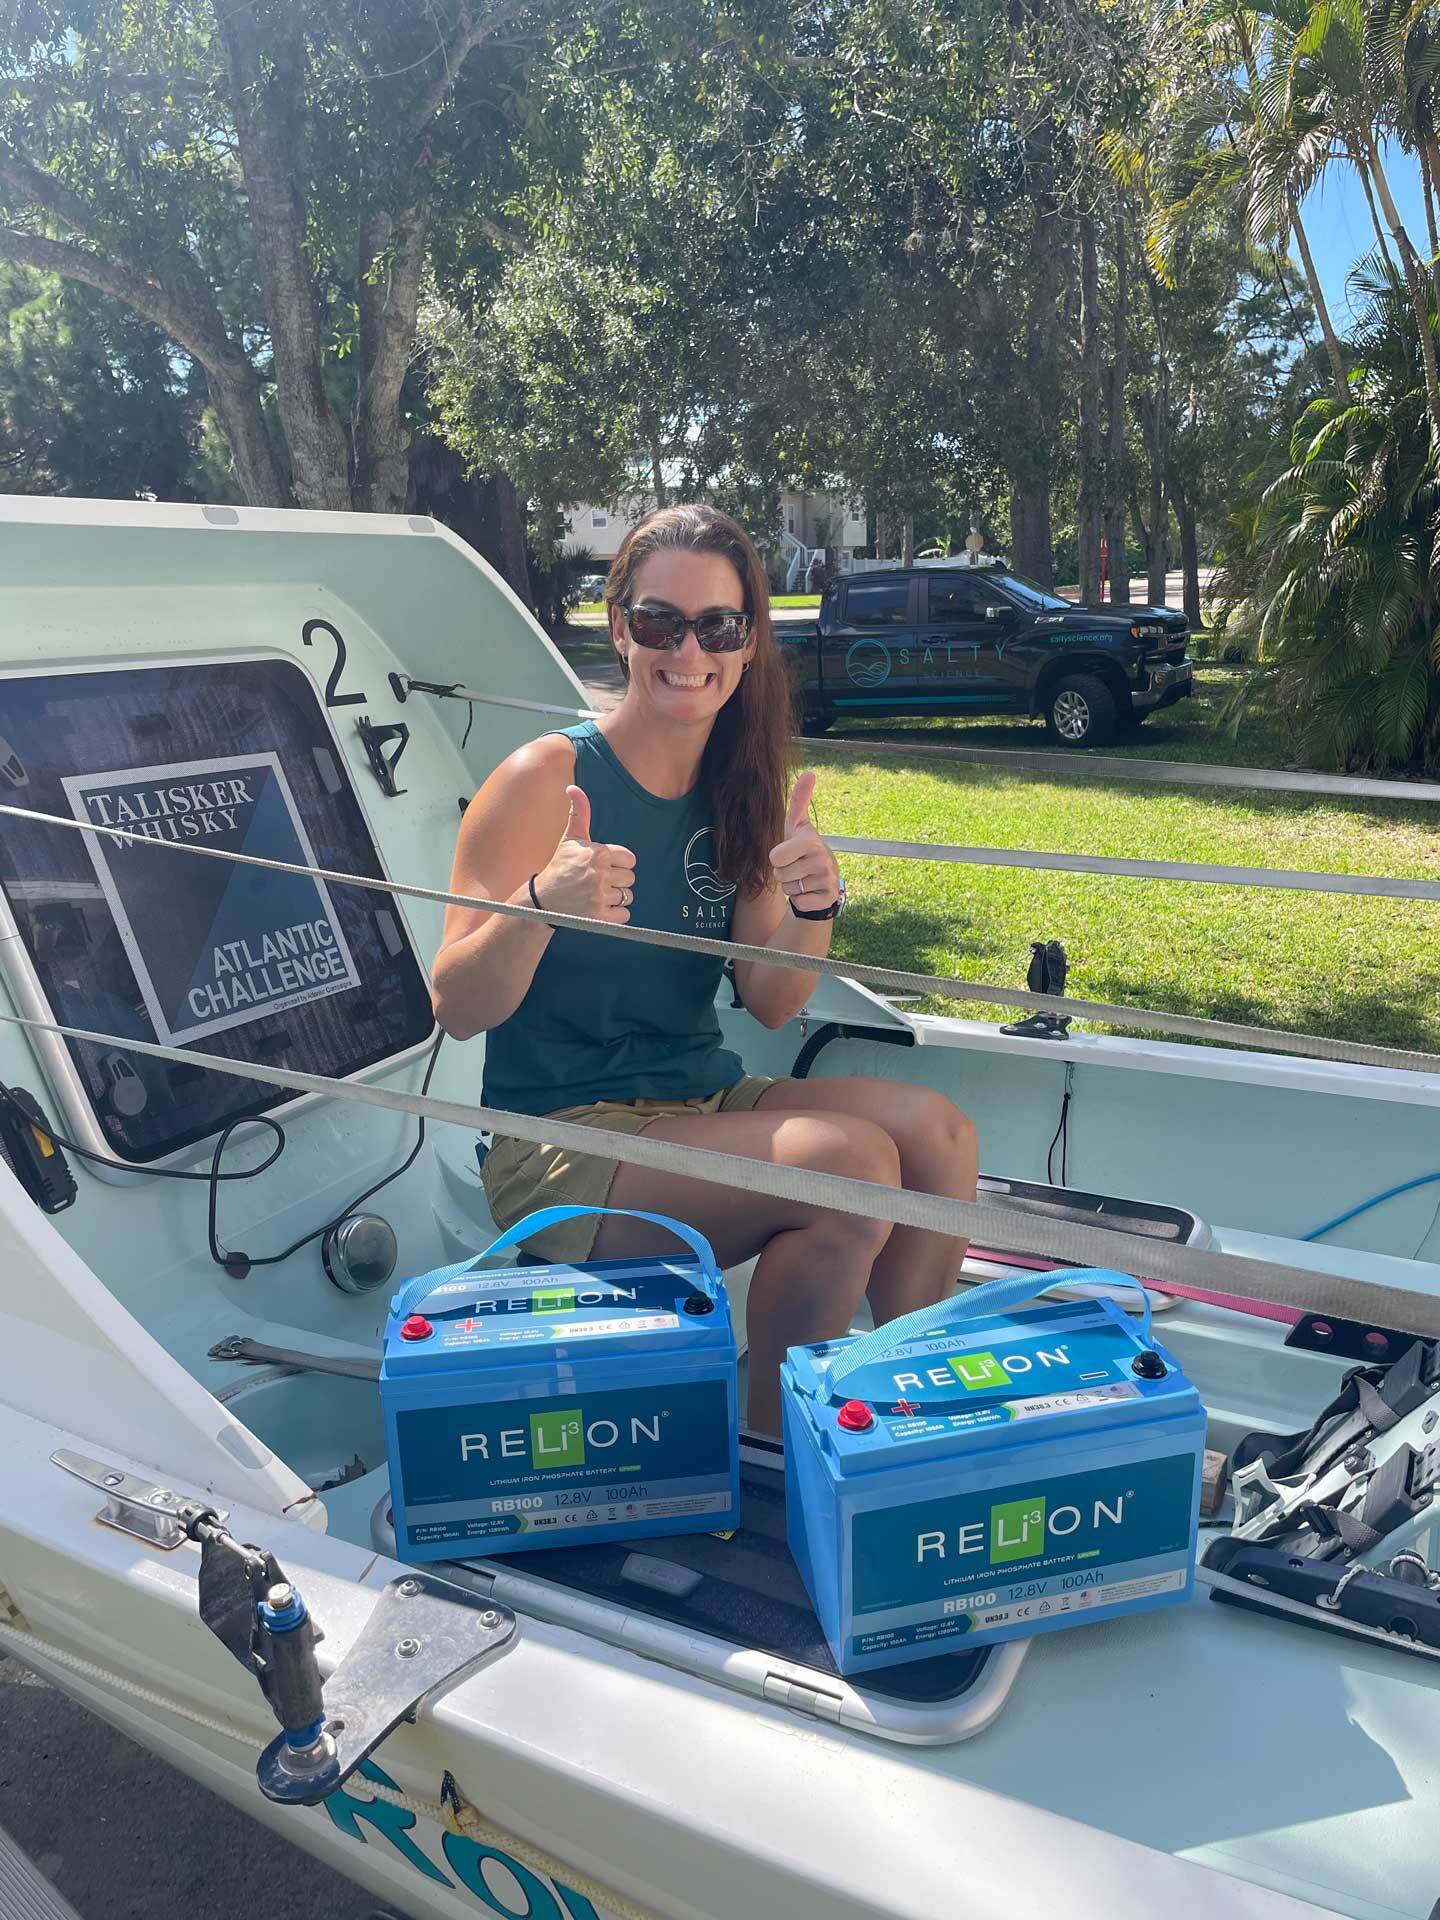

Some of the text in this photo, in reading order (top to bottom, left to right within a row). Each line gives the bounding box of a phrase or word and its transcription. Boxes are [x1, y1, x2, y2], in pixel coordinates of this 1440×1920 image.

[302, 619, 367, 707] 2
[899, 643, 1006, 665] SALTY
[107, 808, 239, 850] WHISKY
[682, 905, 727, 918] SALT
[695, 921, 726, 929] SCIENCE
[213, 919, 333, 978] ATLANTIC
[188, 946, 346, 1018] CHALLENGE
[478, 1281, 511, 1289] 12.8V
[522, 1277, 560, 1286] 100Ah
[881, 1339, 967, 1359] 12.8V 100Ah
[489, 1476, 521, 1486] LITHIUM
[521, 1474, 540, 1484] IRON
[541, 1471, 585, 1481] PHOSPHATE
[585, 1467, 617, 1476] BATTERY
[491, 1485, 648, 1513] RB100 12.8V 100Ah
[533, 1517, 557, 1526] UN38.3
[943, 1555, 1075, 1586] LITHIUM IRON PHOSPHATE BATTERY
[943, 1592, 997, 1614] RB100
[1008, 1581, 1048, 1600] 12.8V
[1062, 1570, 1104, 1590] 100Ah
[985, 1612, 1009, 1624] UN38.3
[323, 1757, 603, 1920] RO
